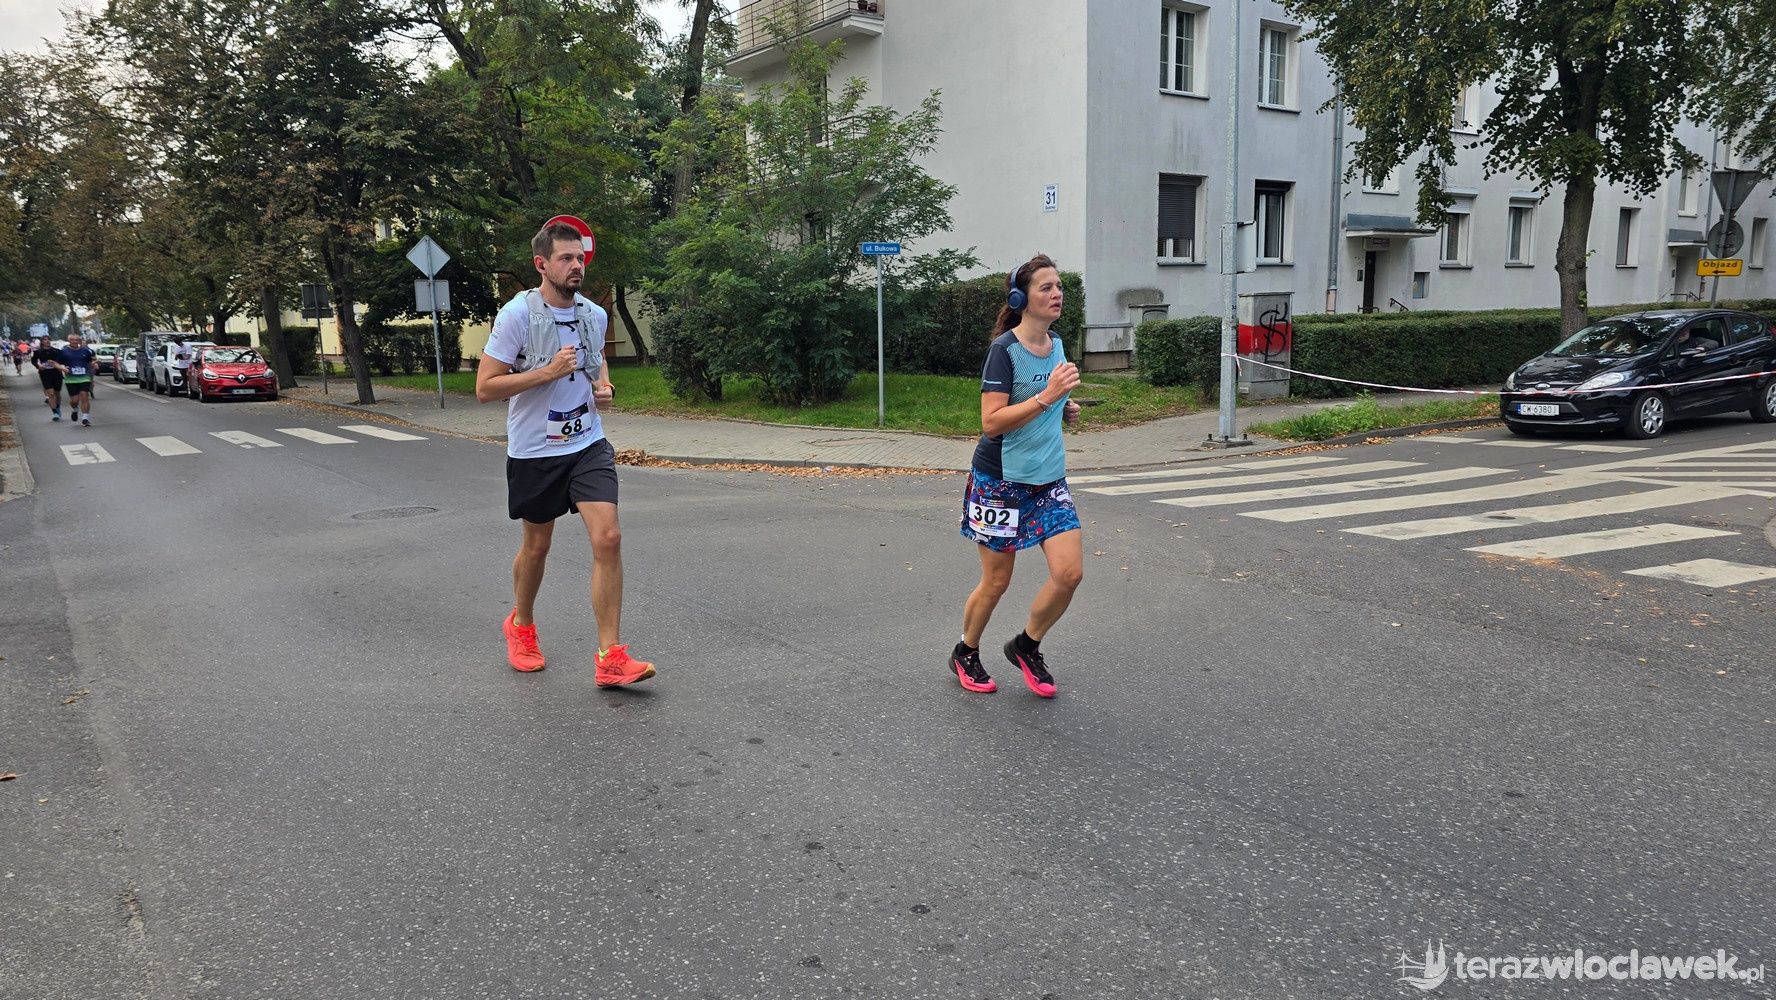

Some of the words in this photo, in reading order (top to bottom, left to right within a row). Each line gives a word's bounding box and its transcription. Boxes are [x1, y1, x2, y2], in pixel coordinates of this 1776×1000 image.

[1045, 191, 1056, 205] 31
[1702, 261, 1738, 269] Objazd
[561, 418, 583, 435] 68
[973, 505, 1011, 526] 302
